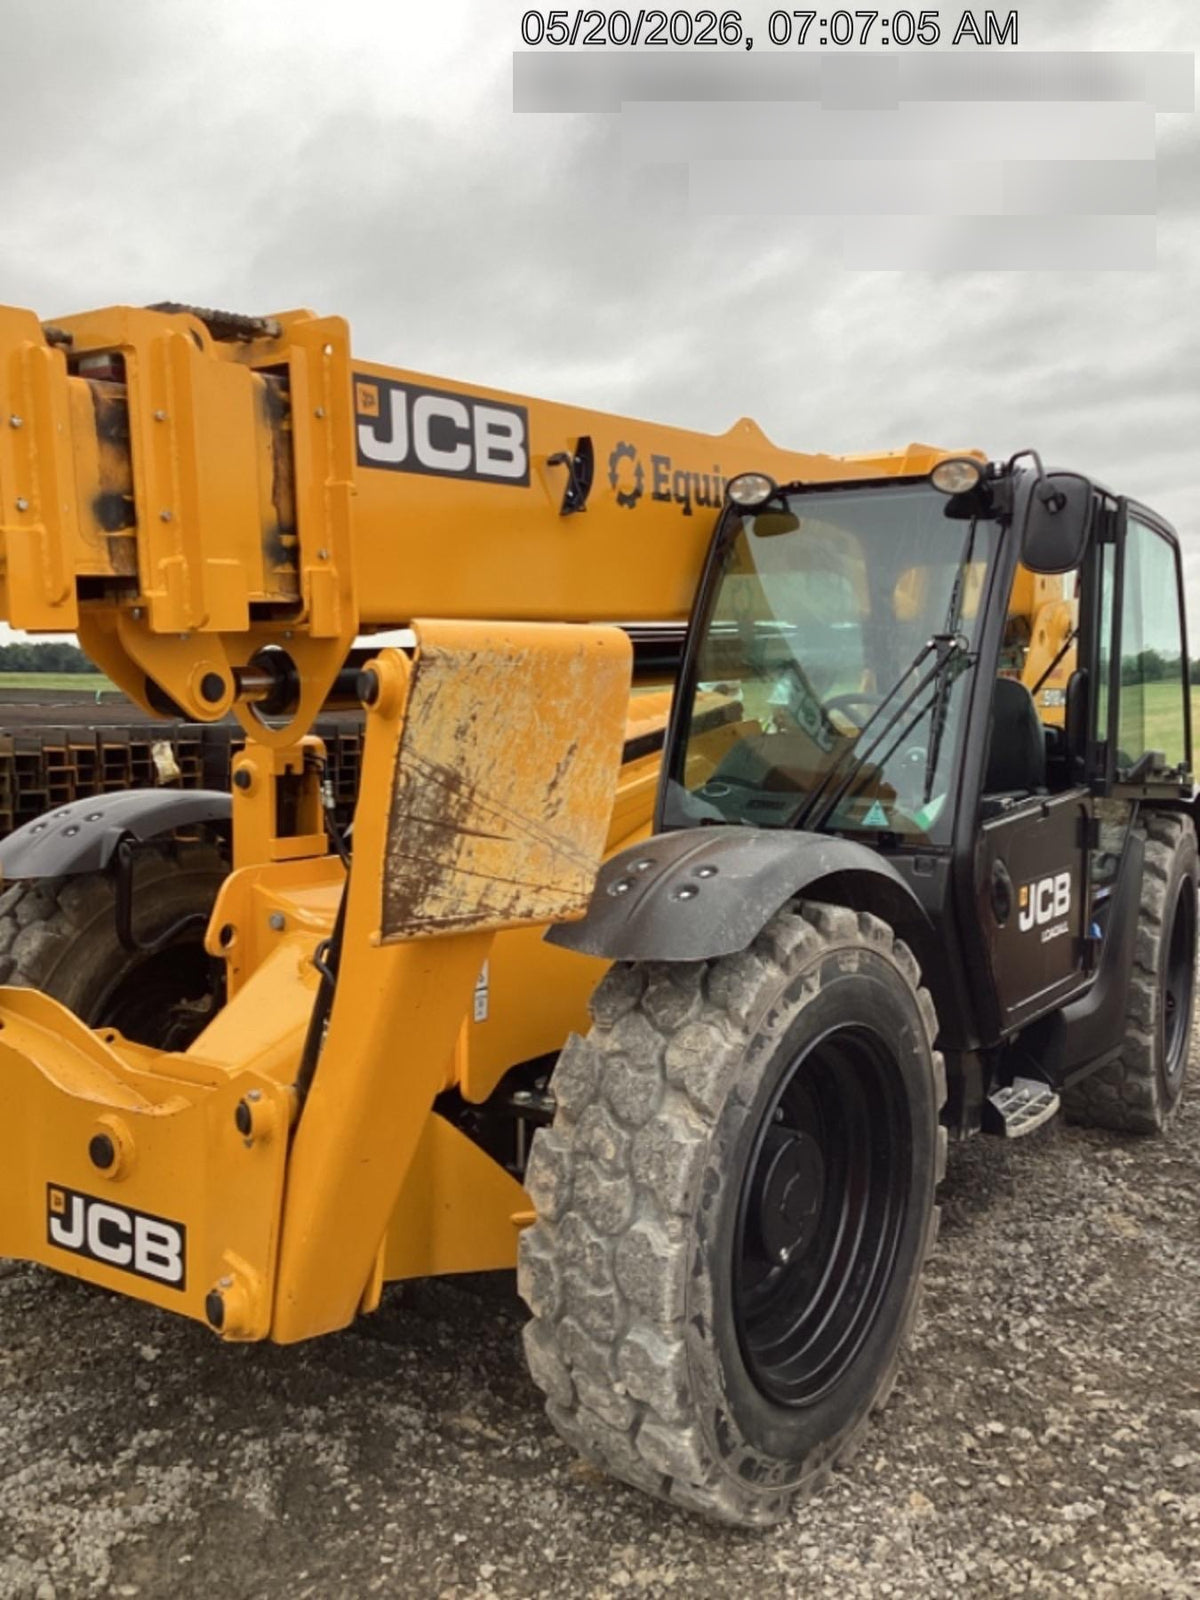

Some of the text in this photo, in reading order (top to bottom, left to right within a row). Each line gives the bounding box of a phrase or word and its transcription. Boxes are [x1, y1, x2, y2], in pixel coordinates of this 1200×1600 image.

[357, 388, 528, 478] JCB
[651, 455, 729, 516] Equi
[1019, 872, 1071, 932] JCB
[50, 1195, 183, 1283] JCB
